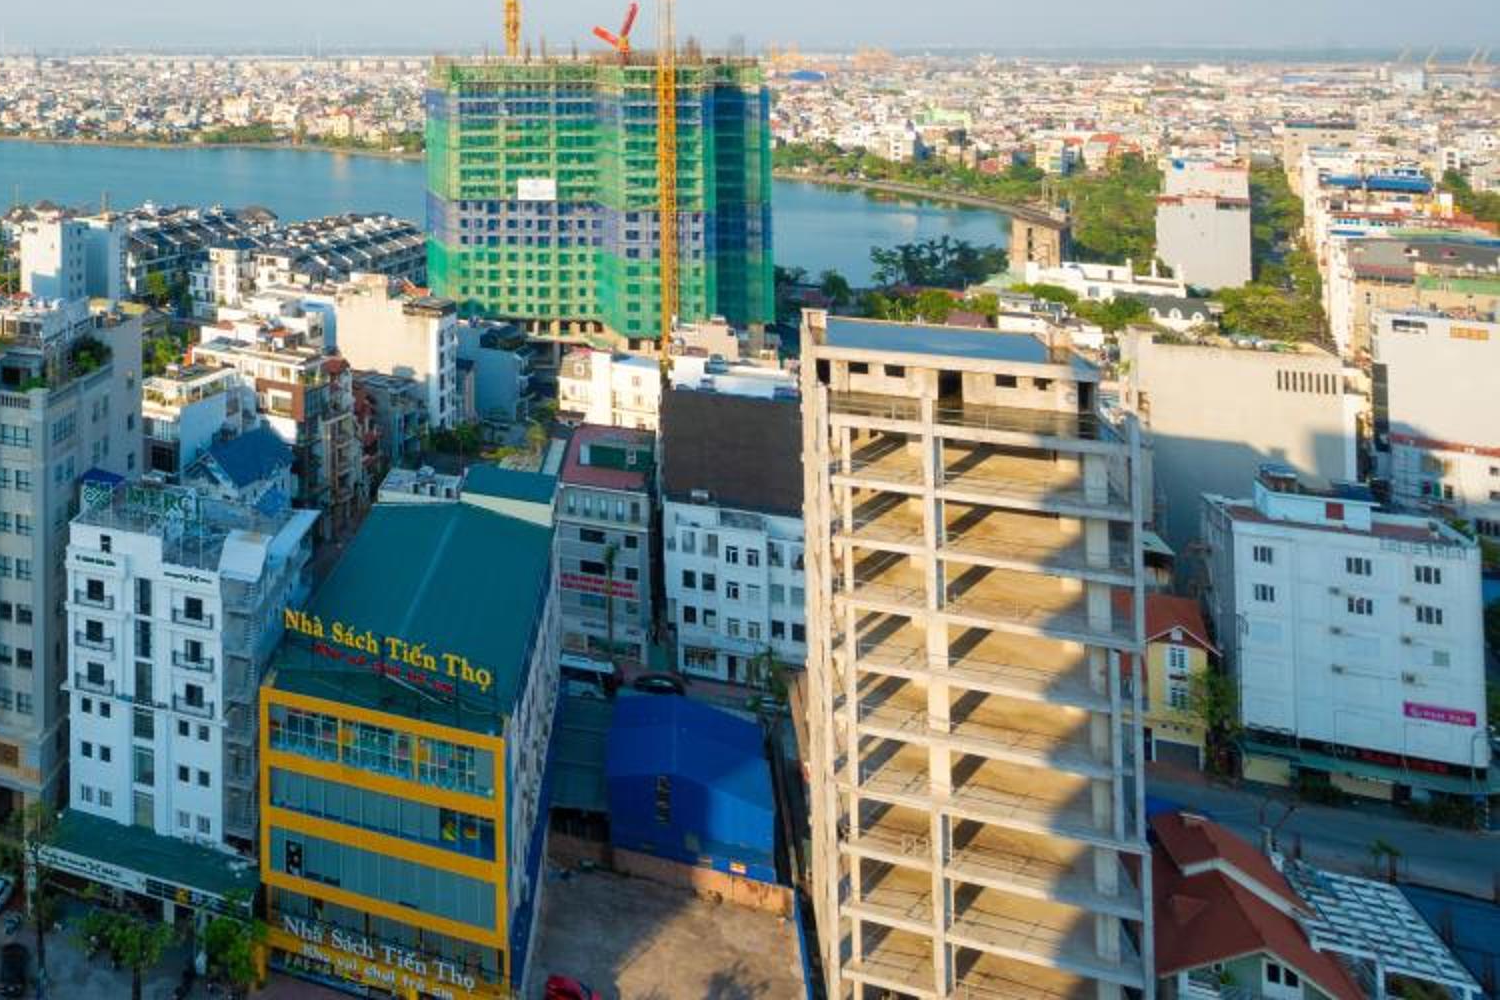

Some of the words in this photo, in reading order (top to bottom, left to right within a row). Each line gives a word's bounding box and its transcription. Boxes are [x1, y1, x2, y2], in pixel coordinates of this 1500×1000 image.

[284, 608, 325, 637] Nhà
[331, 622, 380, 655] Sách
[384, 637, 437, 671] Tiến
[442, 653, 494, 692] Thọ
[283, 915, 323, 944] Nhà
[331, 927, 374, 959] Sách
[379, 943, 428, 976] Tiến
[432, 957, 476, 993] Thọ
